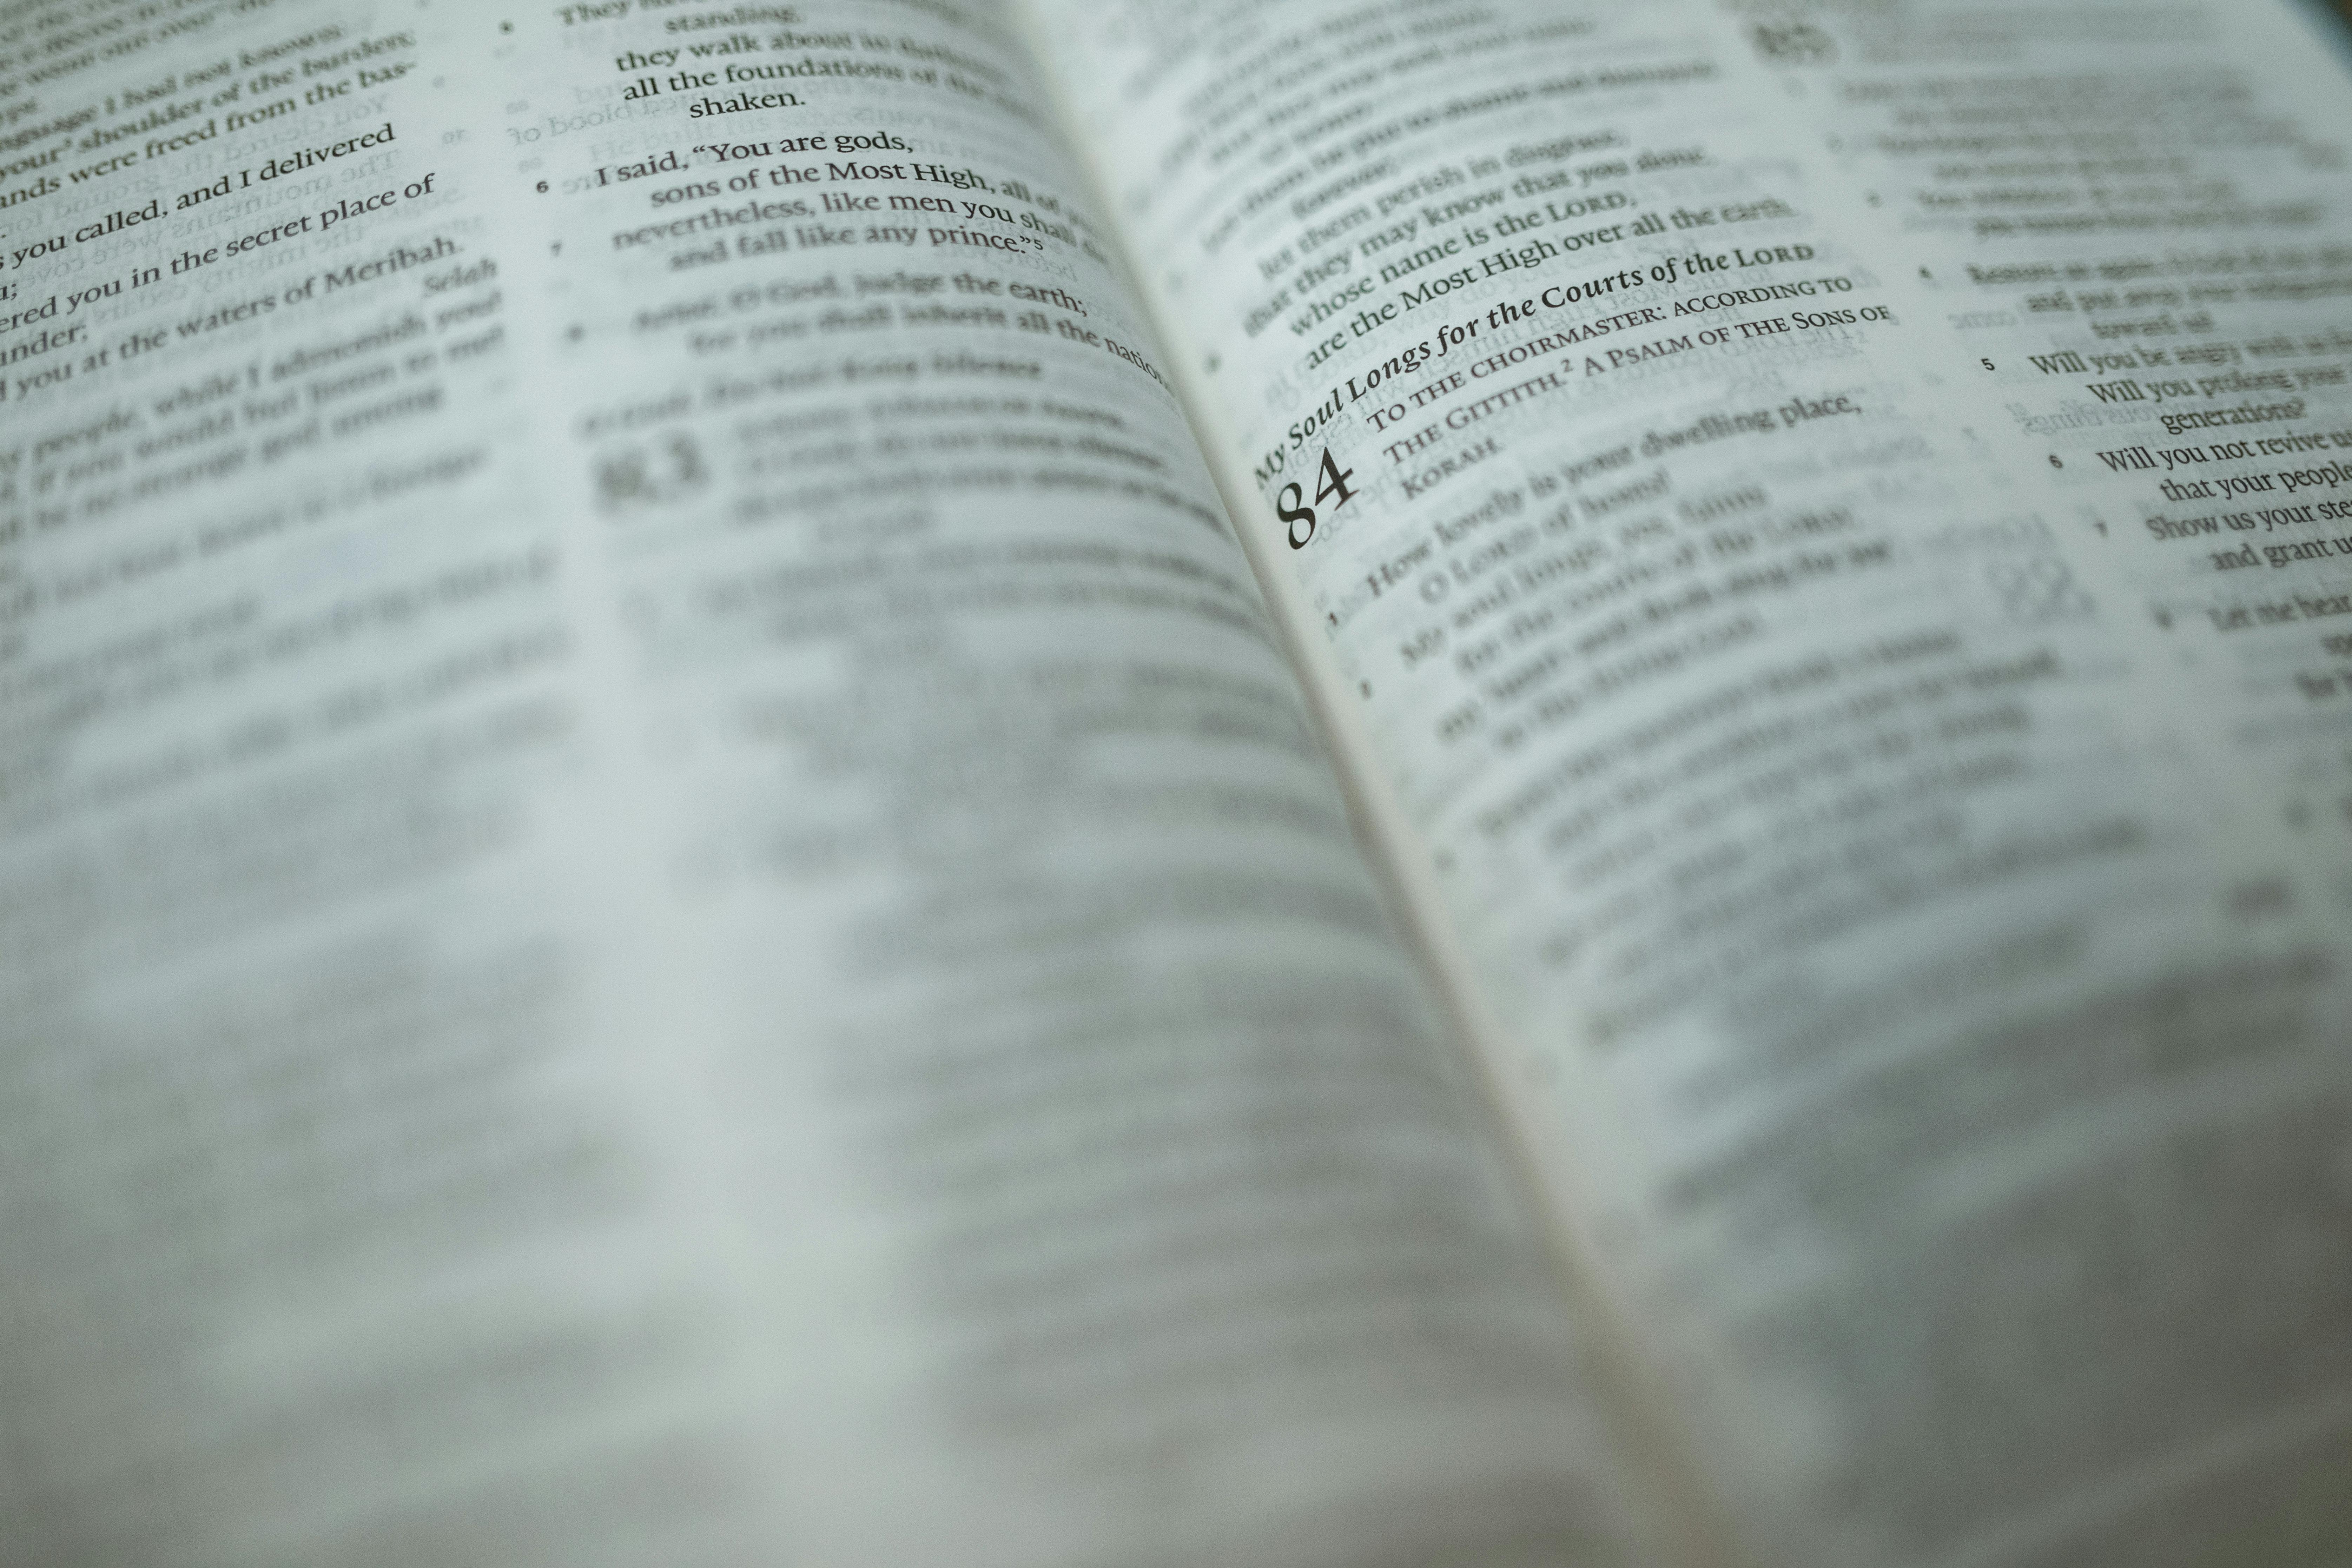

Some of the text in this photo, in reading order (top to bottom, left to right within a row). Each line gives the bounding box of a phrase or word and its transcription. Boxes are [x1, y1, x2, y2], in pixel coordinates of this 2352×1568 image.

[615, 47, 680, 71] they
[687, 33, 761, 58] walk
[623, 78, 661, 100] all
[668, 71, 719, 92] the
[689, 92, 806, 118] shaken.
[69, 151, 138, 184] were
[145, 118, 217, 159] freed
[226, 97, 297, 132] from
[305, 80, 350, 105] the
[594, 131, 913, 187] I said, “You are gods,
[12, 236, 68, 269] you
[75, 199, 169, 243] called,
[177, 175, 232, 210] and
[239, 170, 252, 189] I
[260, 123, 396, 181] delivered
[536, 180, 549, 193] 6
[650, 179, 722, 208] sons
[728, 169, 760, 192] of
[768, 164, 821, 186] the
[825, 162, 908, 181] Most
[909, 163, 996, 194] High,
[66, 280, 123, 315] you
[131, 266, 162, 289] in
[170, 246, 219, 275] the
[226, 215, 312, 257] secret
[319, 200, 396, 231] place
[404, 172, 435, 199] of
[612, 199, 815, 251] nevertheless,
[819, 192, 881, 214] like
[887, 193, 962, 214] men
[959, 200, 1017, 225] you
[793, 223, 857, 251] like
[863, 225, 918, 247] any
[1359, 217, 1419, 257] may
[1422, 186, 1506, 226] know
[1009, 281, 1087, 316] earth;
[1290, 277, 1377, 337] whose
[1379, 237, 1461, 284] name
[1462, 226, 1491, 247] is
[1494, 209, 1544, 239] the
[1305, 204, 1719, 370] are the Most High over all the
[82, 348, 109, 373] at
[119, 330, 168, 359] the
[177, 294, 277, 338] waters
[284, 276, 317, 305] of
[324, 235, 465, 293] Meribah.
[1288, 387, 1344, 450] Soul
[1345, 340, 1431, 403] Longs
[1437, 318, 1479, 358] for
[1486, 299, 1537, 330] the
[1540, 267, 1644, 309] Courts
[1650, 257, 1686, 282] of
[1684, 251, 1731, 278] the
[1733, 243, 1816, 268] LORD
[1366, 275, 1854, 433] TO THE CHOIRMASTER: ACCORDING TO
[1981, 357, 1996, 371] 5
[2027, 350, 2090, 376] Will
[2089, 348, 2139, 375] you
[1382, 423, 1444, 466] THE
[1583, 356, 1607, 378] A
[1605, 335, 1696, 370] PSALM
[1699, 327, 1732, 346] OF
[1733, 317, 1792, 340] THE
[1792, 309, 1857, 331] SONS
[1859, 305, 1892, 322] OF
[2086, 378, 2147, 404] Will
[2144, 376, 2195, 403] you
[1779, 395, 1863, 428] place,
[2049, 429, 2330, 473] 6 Will you not revive
[1276, 446, 1361, 550] 84
[2159, 478, 2218, 502] that
[2215, 474, 2277, 500] your
[2145, 501, 2352, 542] Show us your ste
[2210, 542, 2264, 571] and
[2262, 538, 2334, 568] grant
